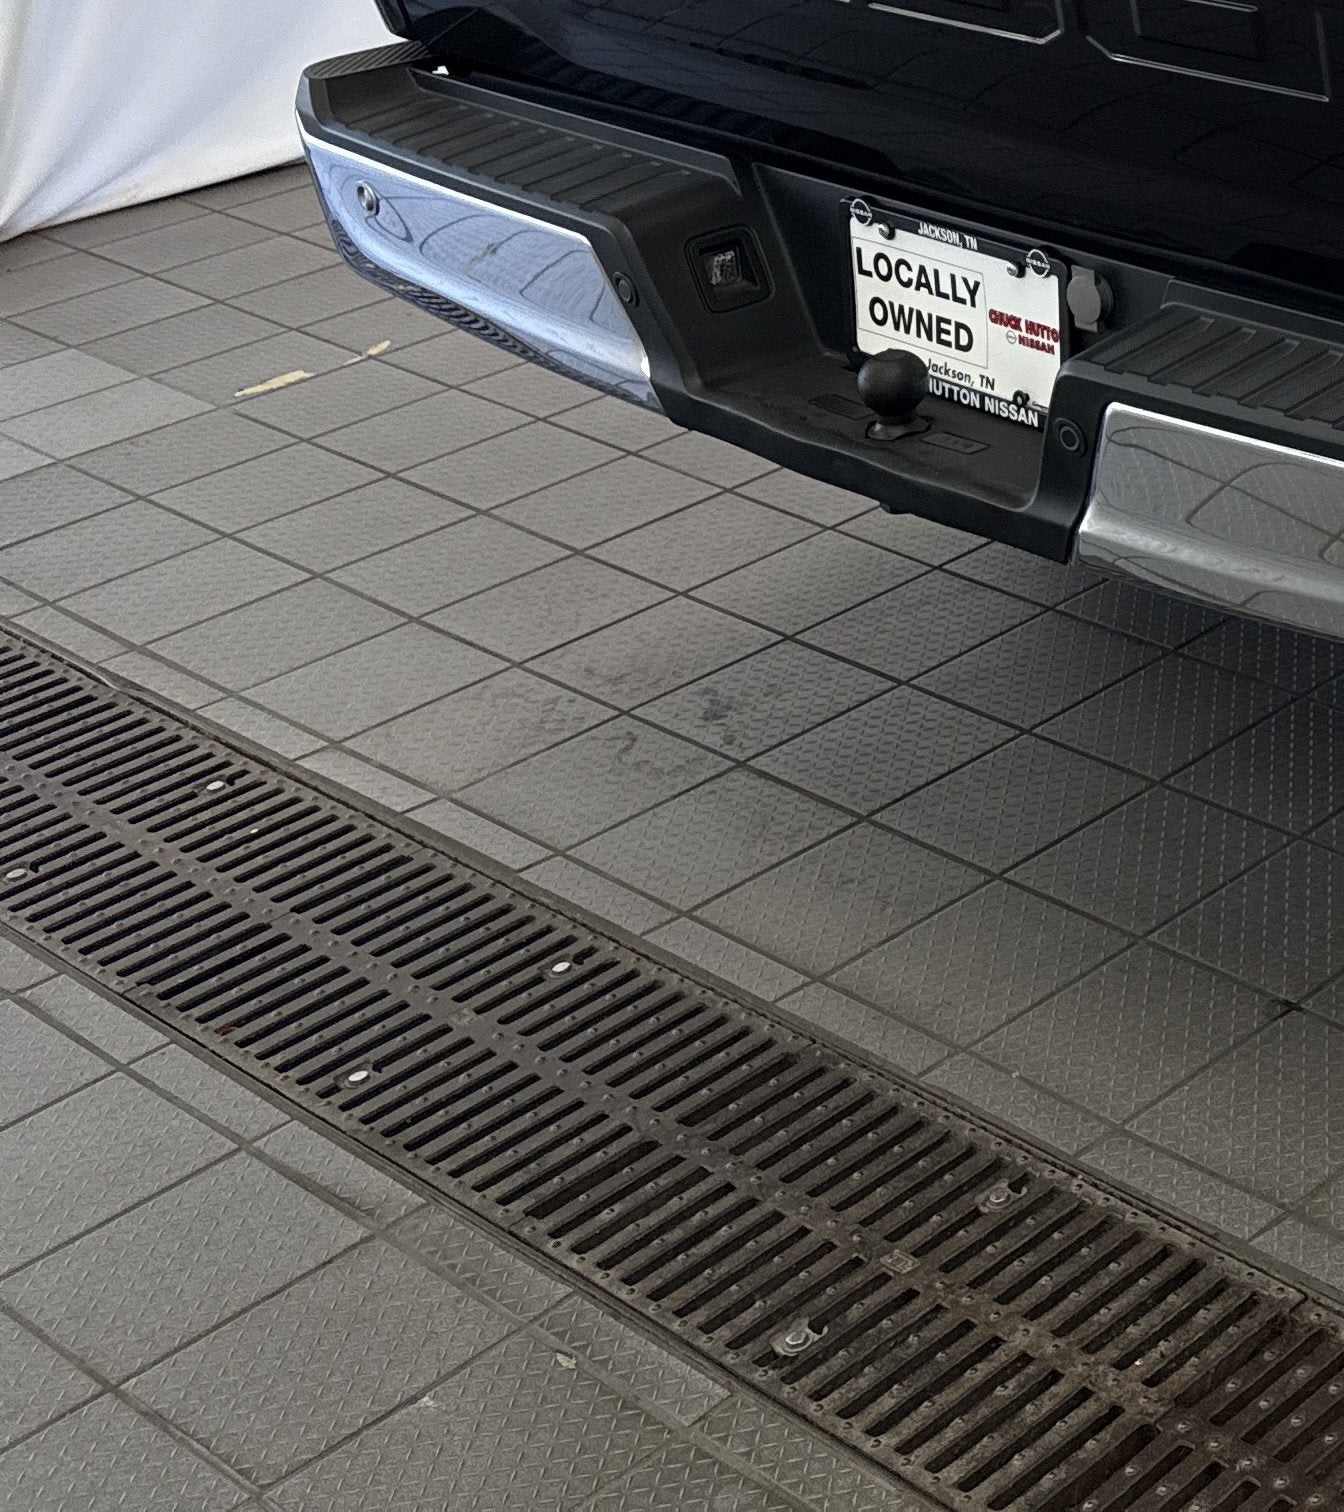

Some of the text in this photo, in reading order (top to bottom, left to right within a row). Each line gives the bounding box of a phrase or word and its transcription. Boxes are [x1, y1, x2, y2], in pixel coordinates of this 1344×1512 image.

[918, 221, 978, 251] JACKSON, TN
[856, 246, 981, 308] LOCALLY
[869, 296, 974, 352] OWNED
[988, 308, 1060, 343] CHUCK HUTTO
[1018, 334, 1055, 355] NISSAN
[927, 357, 996, 391] Jackson, TN
[984, 396, 1039, 428] NISSAN
